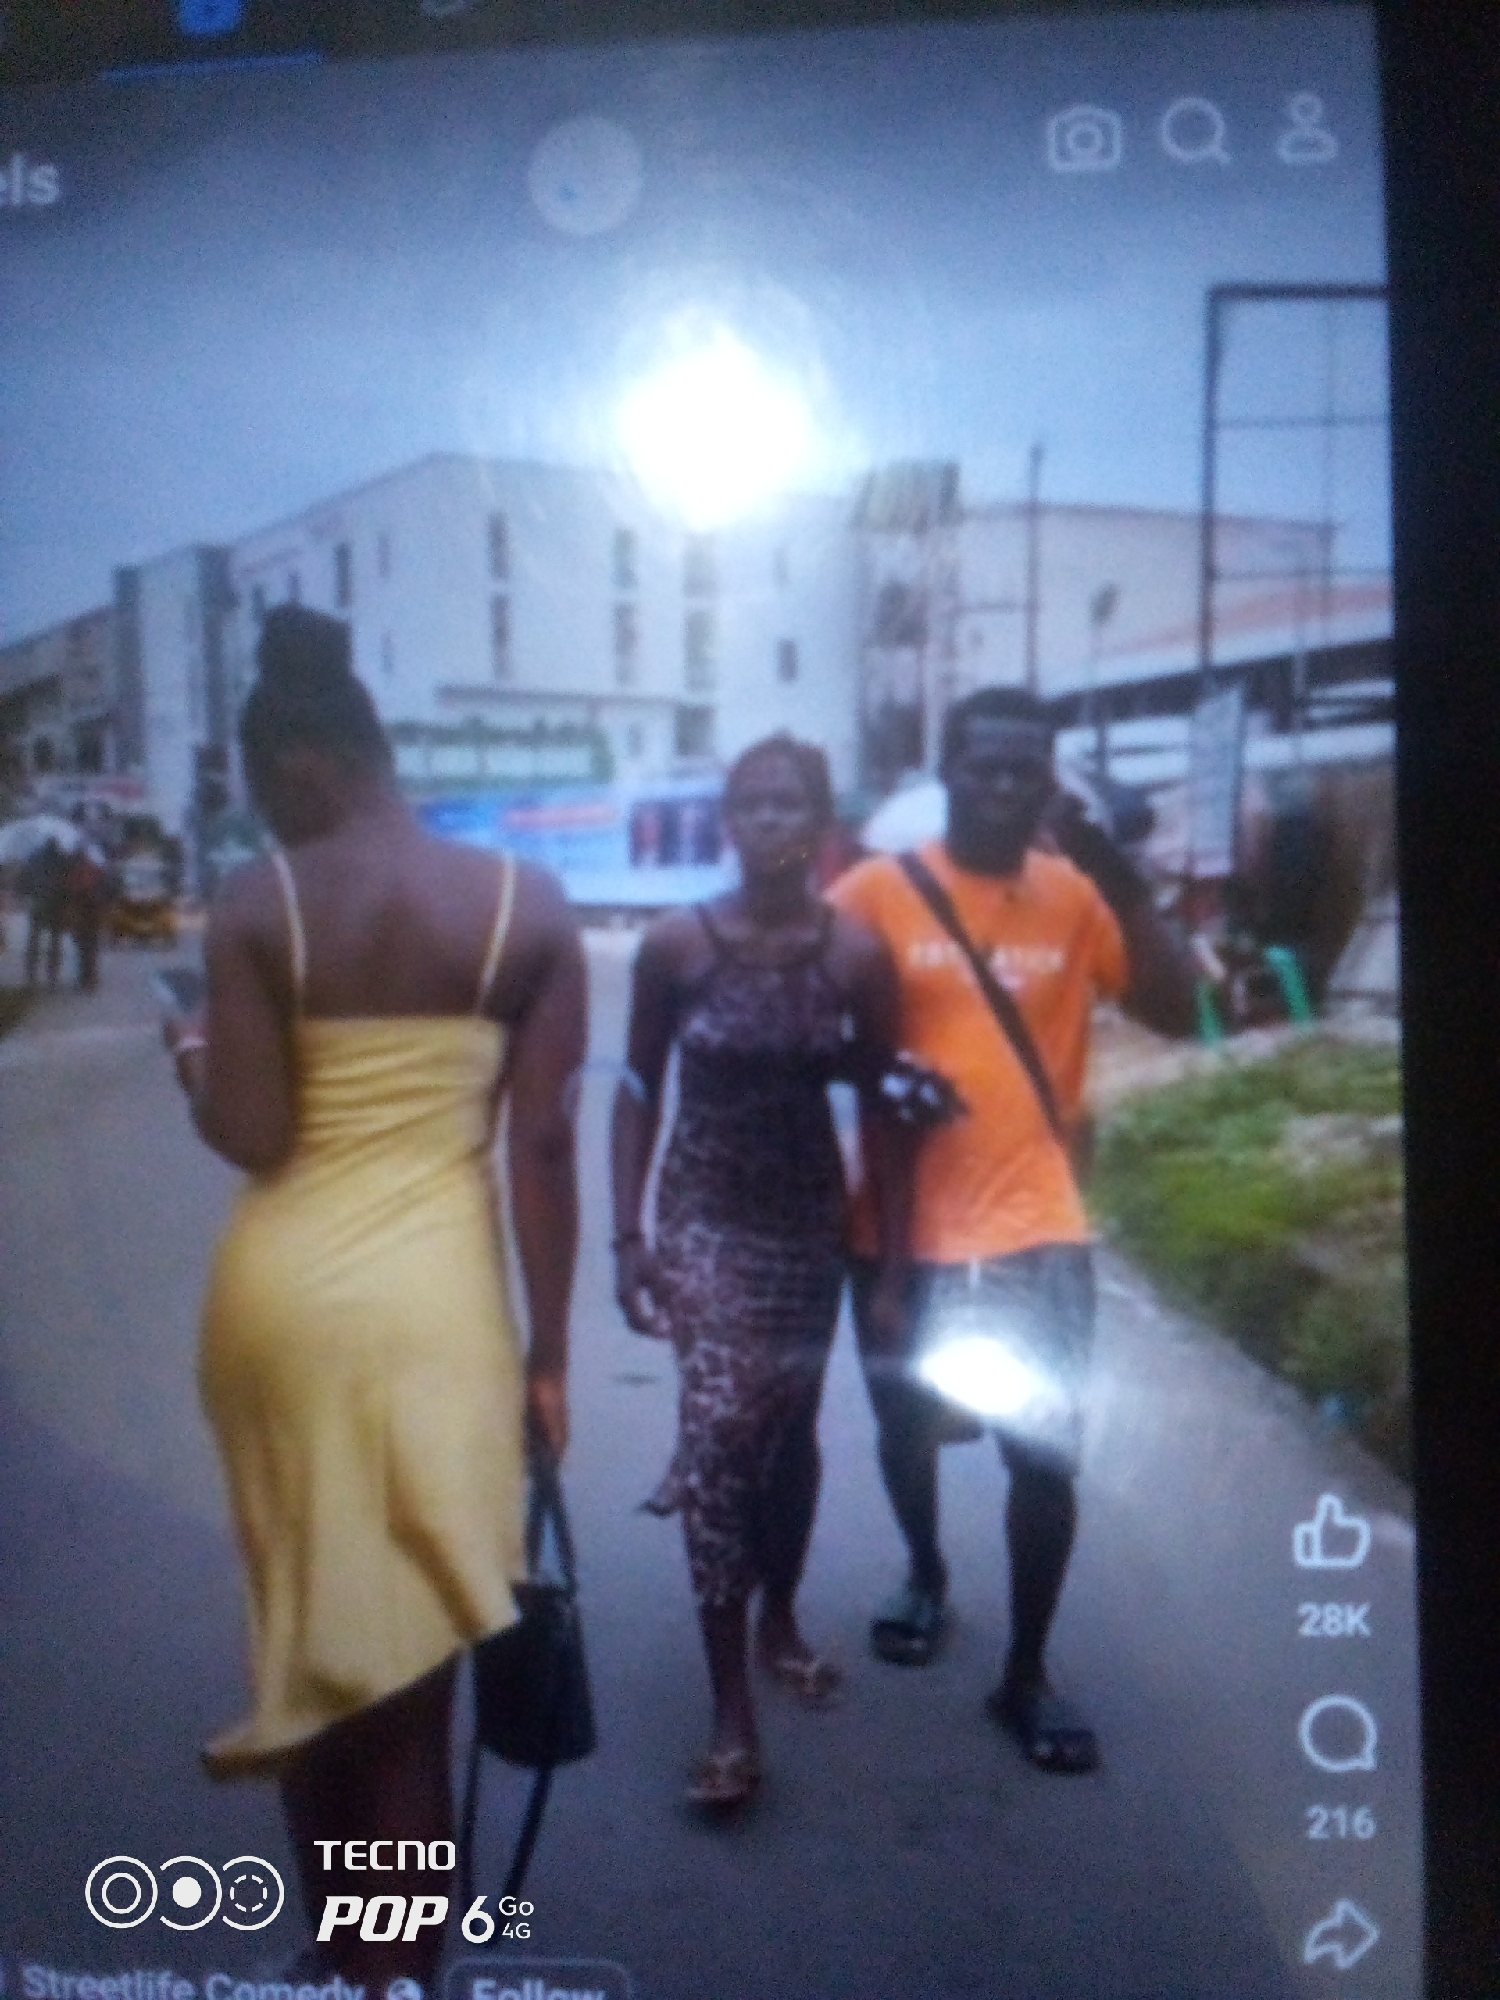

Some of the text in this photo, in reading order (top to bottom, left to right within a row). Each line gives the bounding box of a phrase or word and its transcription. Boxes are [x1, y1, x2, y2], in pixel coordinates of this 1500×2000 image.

[1298, 1602, 1371, 1636] 28K
[1306, 1804, 1376, 1840] 216
[22, 1965, 196, 2000] Streetlife
